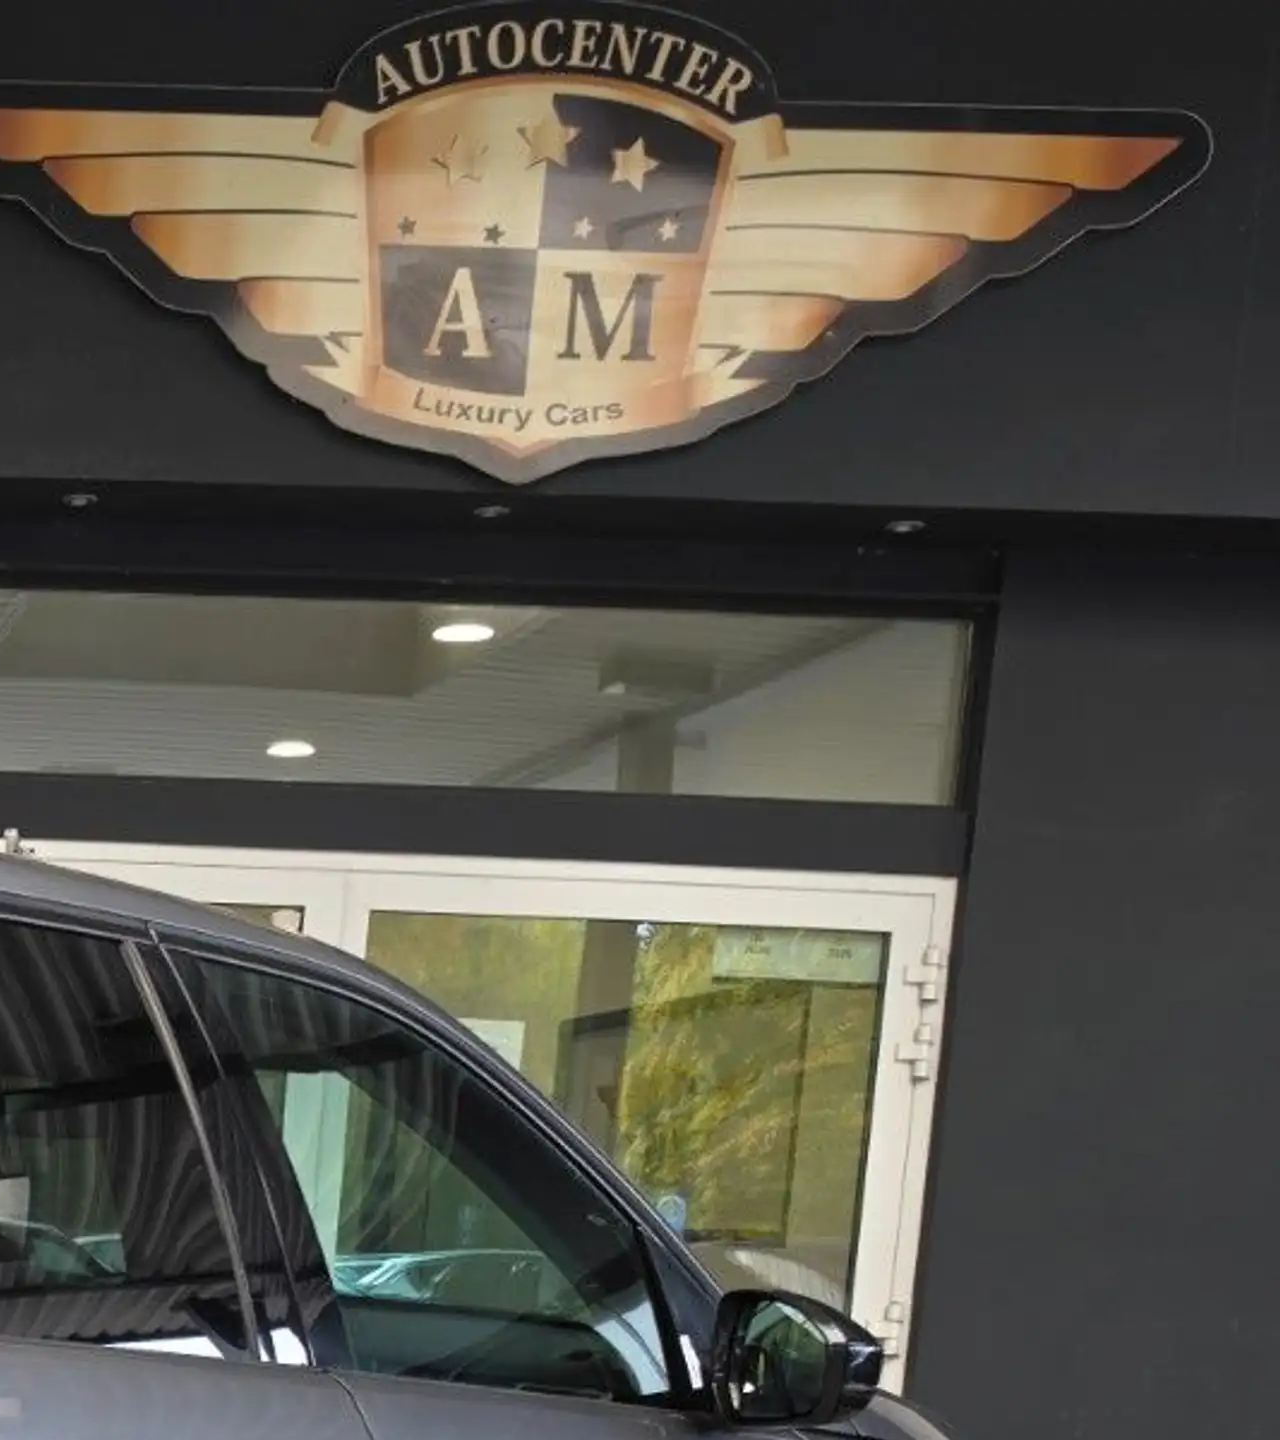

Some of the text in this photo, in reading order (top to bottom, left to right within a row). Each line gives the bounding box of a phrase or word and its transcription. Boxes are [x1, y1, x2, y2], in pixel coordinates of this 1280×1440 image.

[374, 18, 753, 116] AUTOCENTER
[423, 266, 665, 361] A M
[412, 387, 624, 432] Luxury Cars
